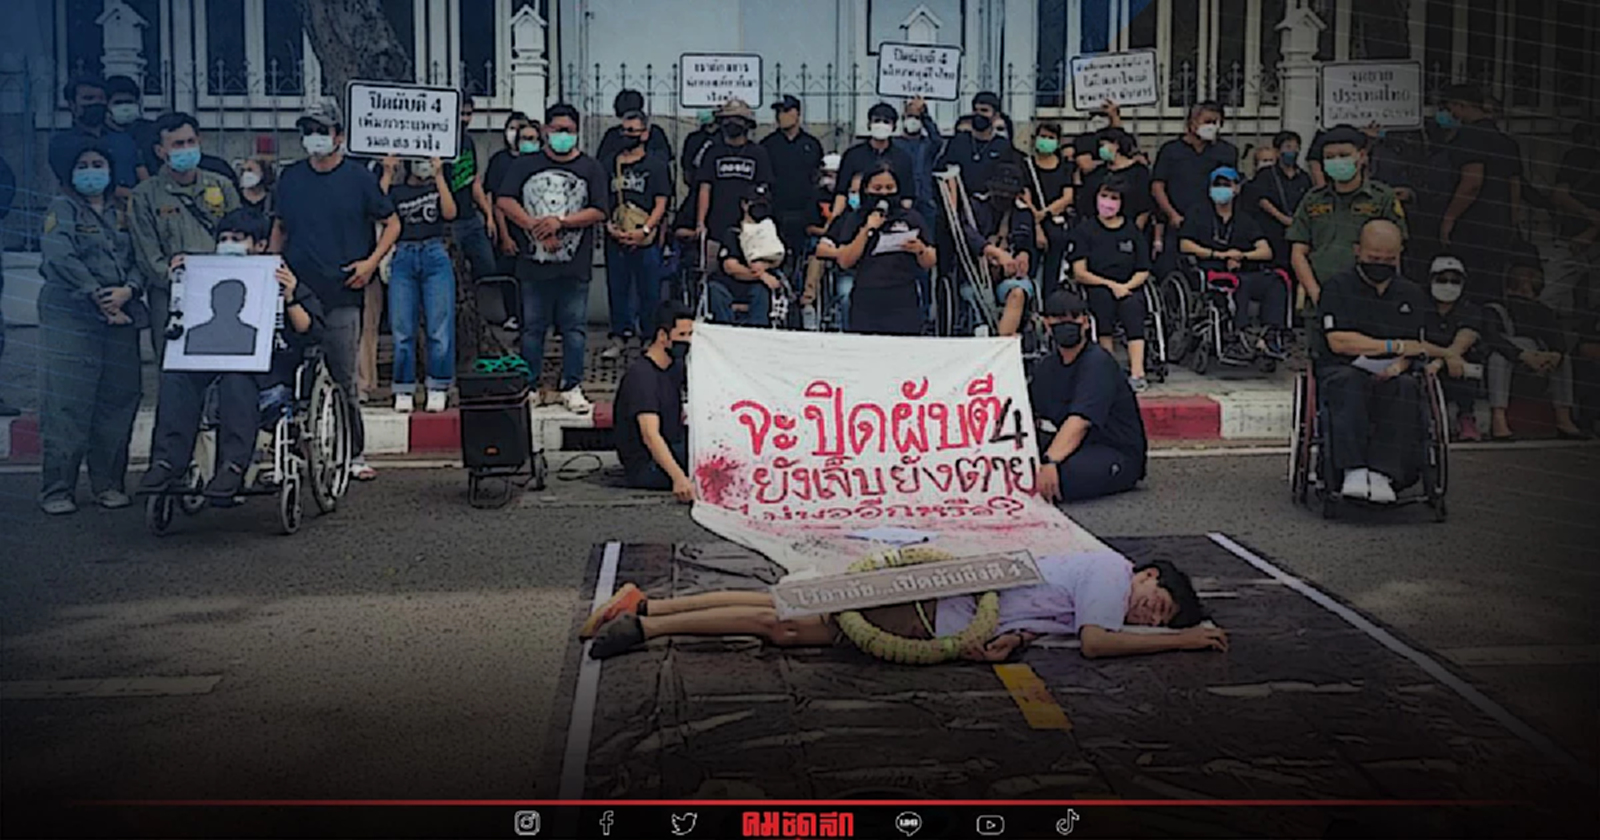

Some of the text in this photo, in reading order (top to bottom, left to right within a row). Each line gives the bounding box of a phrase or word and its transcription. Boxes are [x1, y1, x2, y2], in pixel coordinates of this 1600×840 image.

[368, 90, 441, 113] ปิดผับตี 4
[1332, 83, 1410, 104] ประเทศไทย
